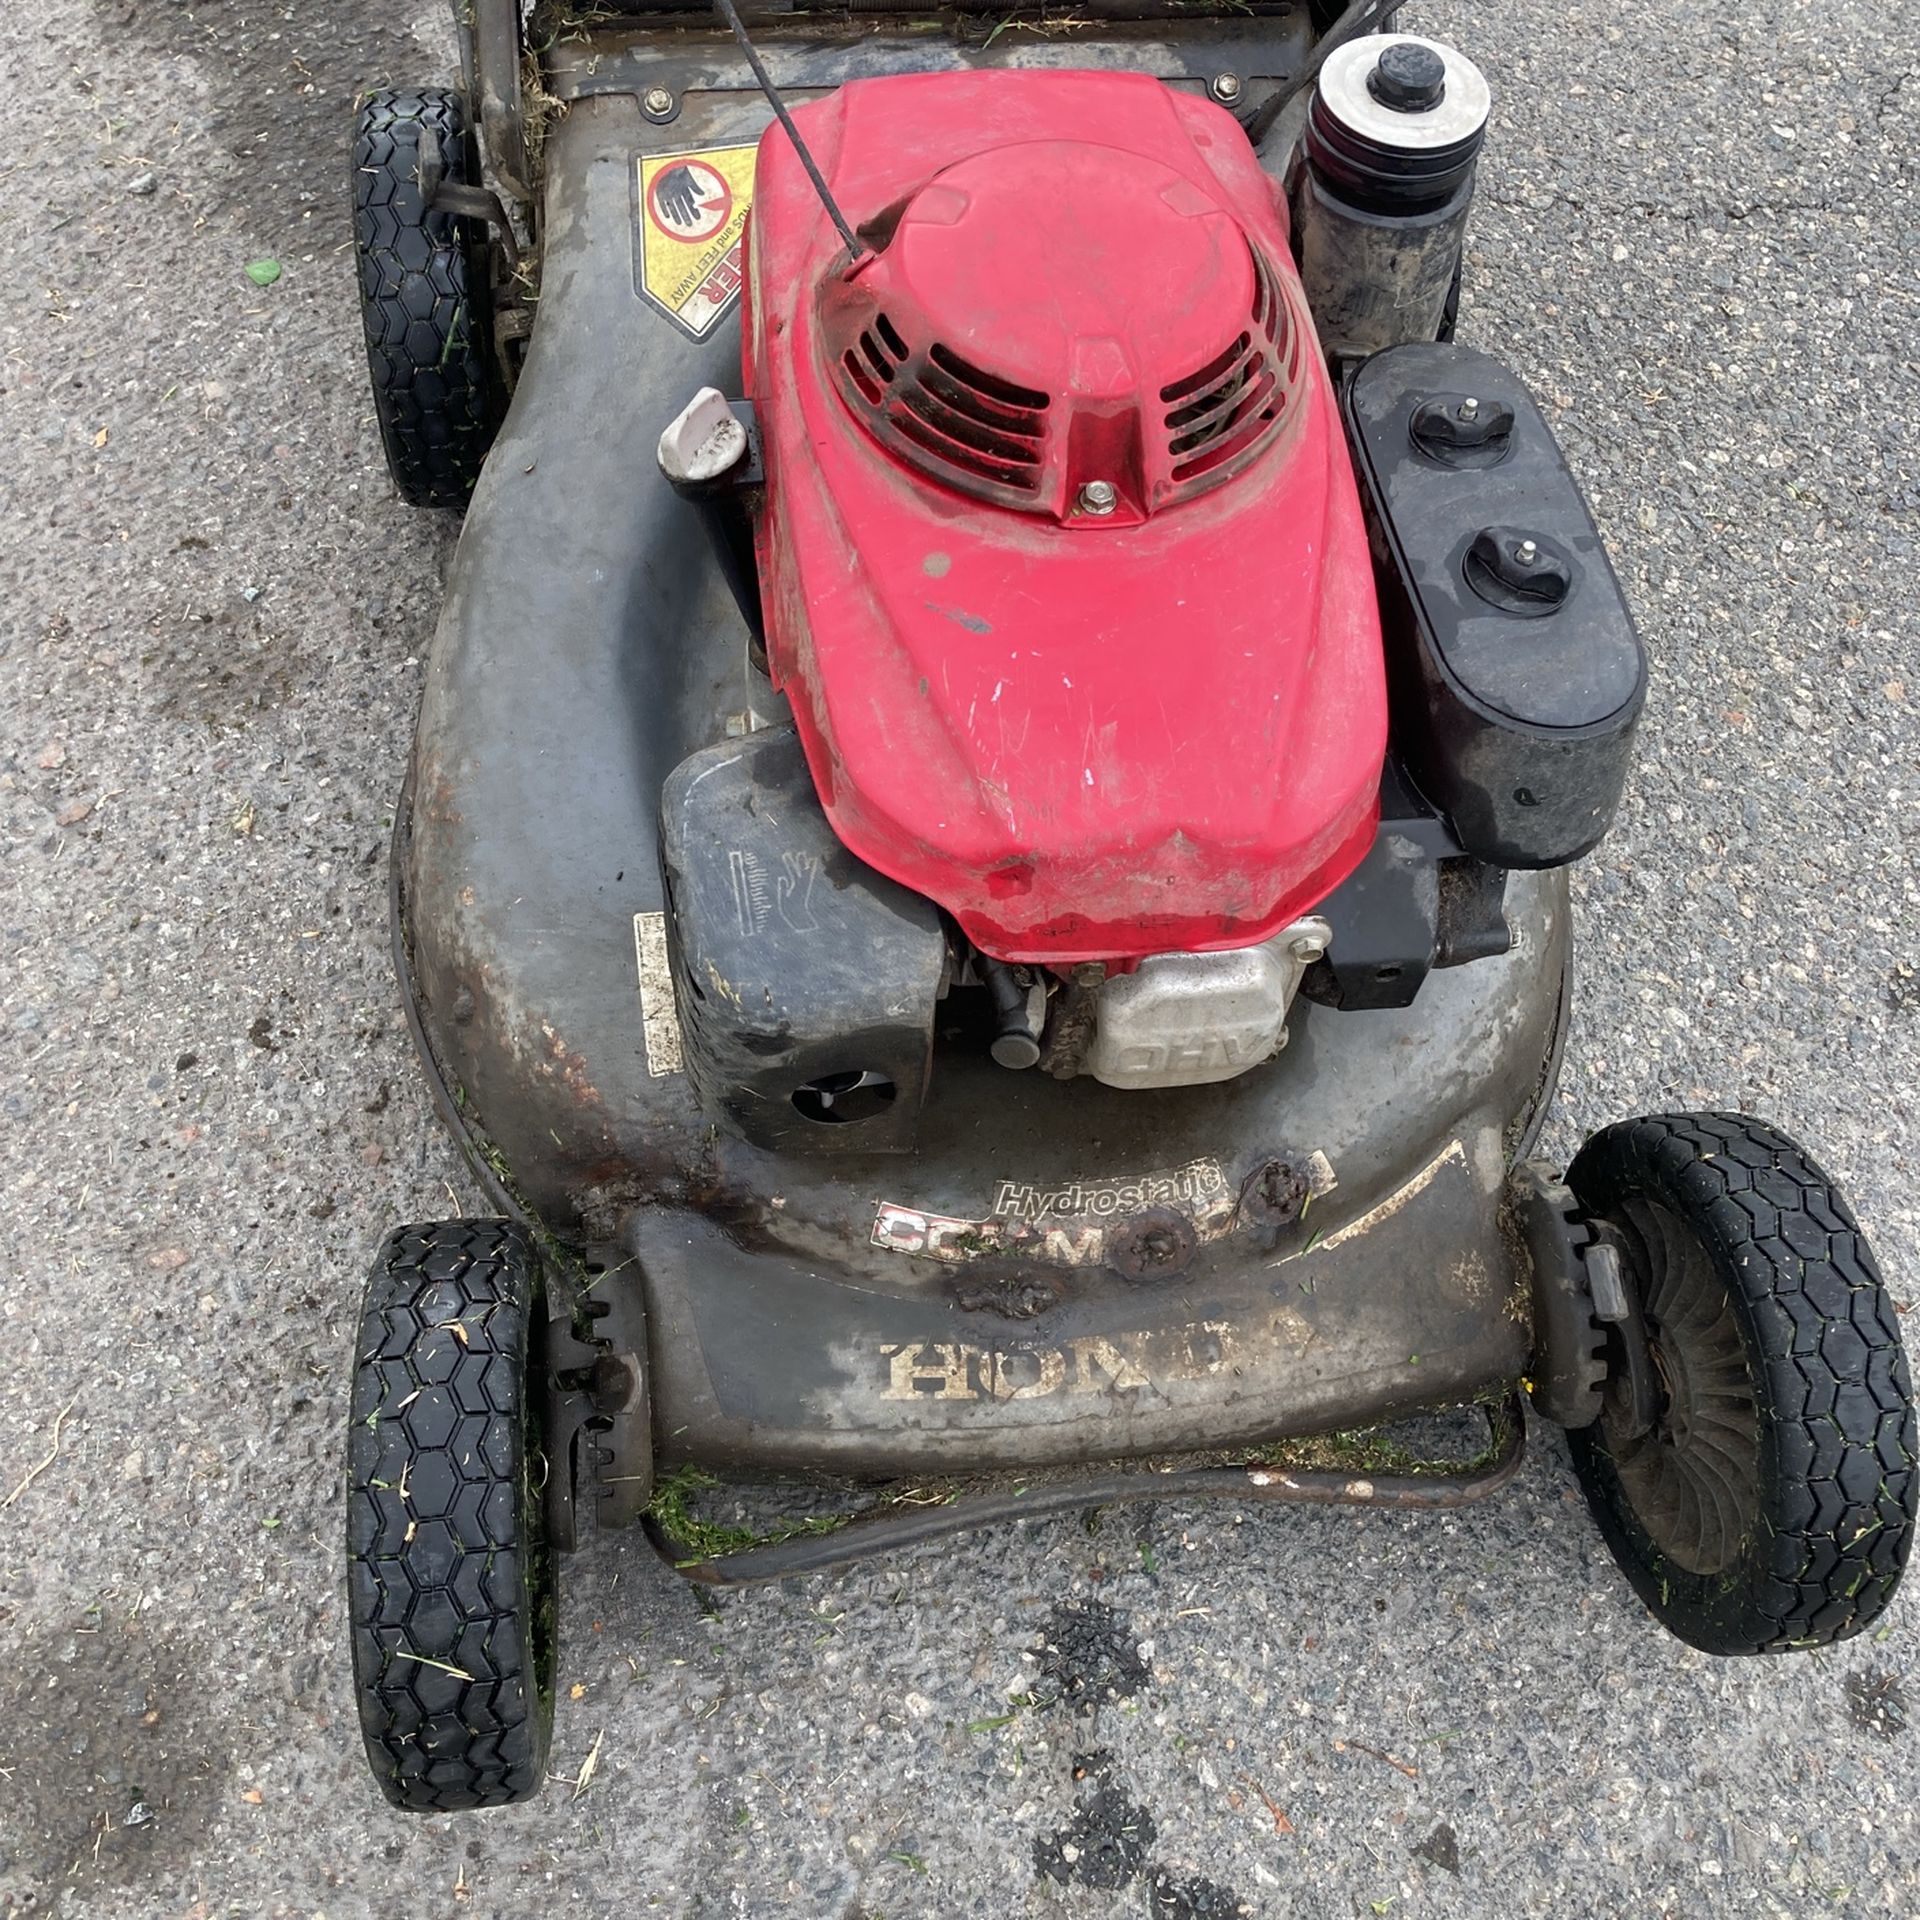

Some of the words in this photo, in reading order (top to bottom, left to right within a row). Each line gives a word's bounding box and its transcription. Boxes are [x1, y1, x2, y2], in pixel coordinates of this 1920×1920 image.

[716, 227, 734, 247] and
[696, 246, 720, 275] FEET
[671, 272, 697, 304] AWAY
[995, 1163, 1221, 1224] Hydrostatic
